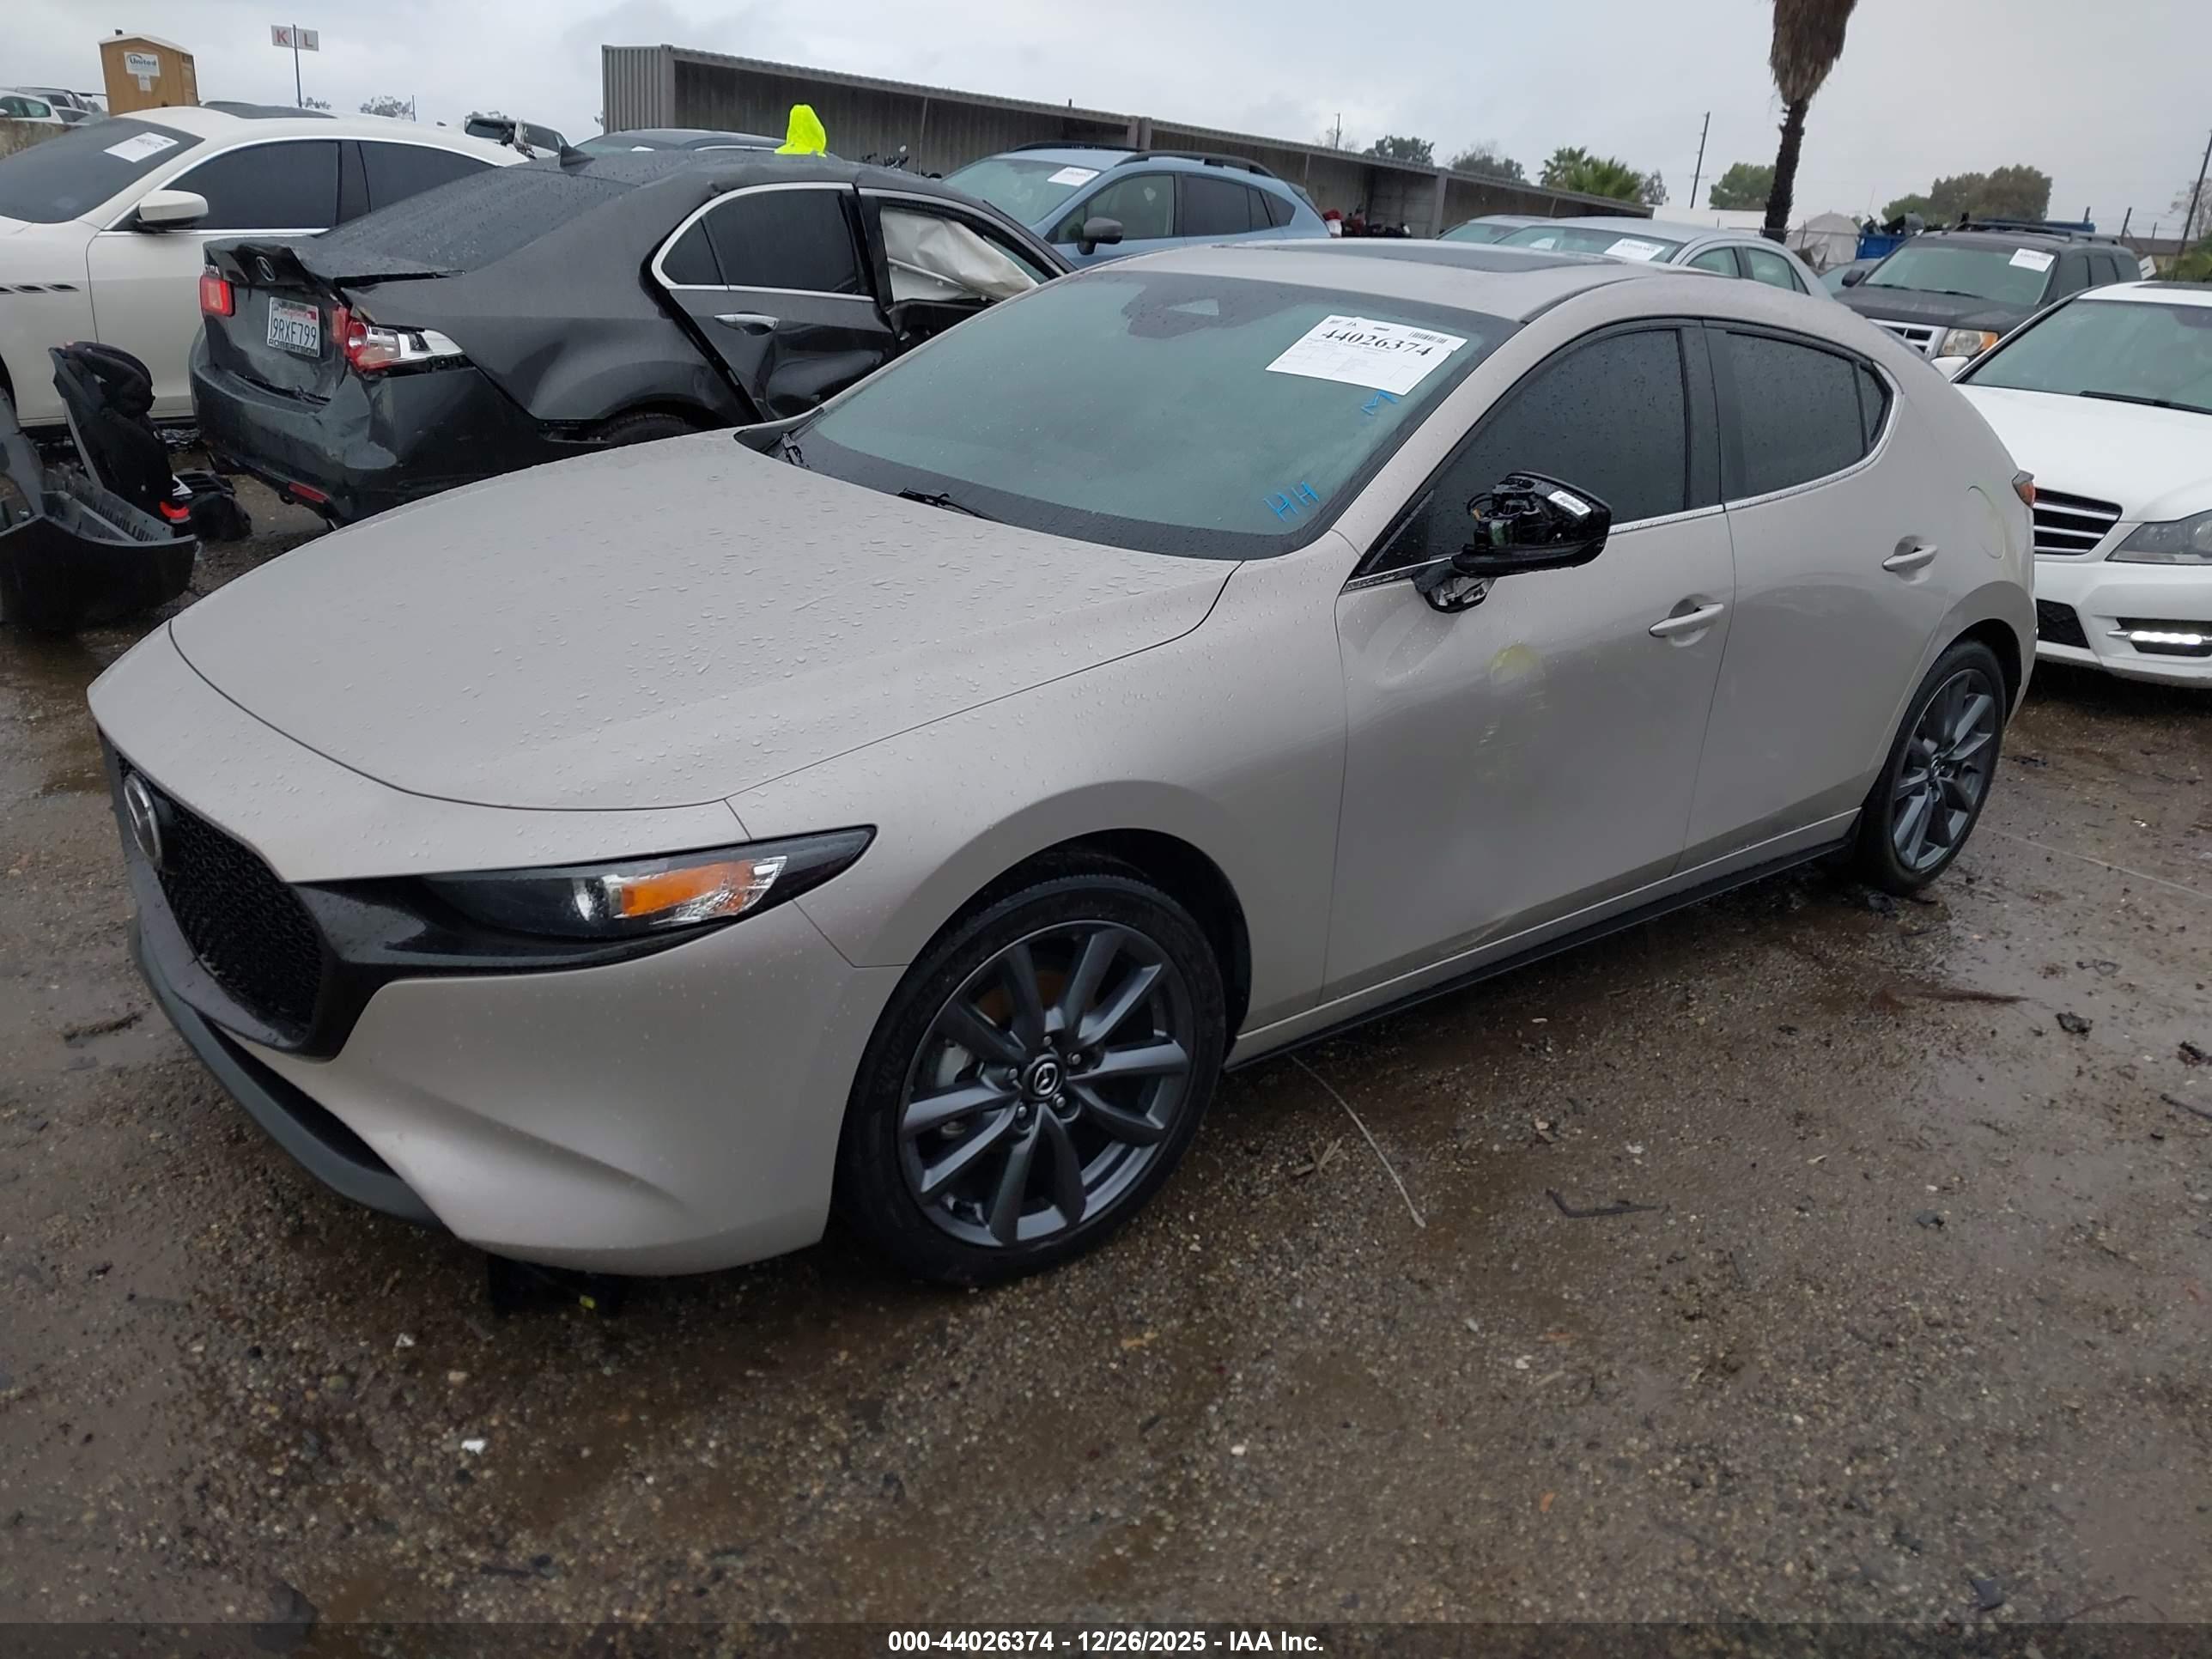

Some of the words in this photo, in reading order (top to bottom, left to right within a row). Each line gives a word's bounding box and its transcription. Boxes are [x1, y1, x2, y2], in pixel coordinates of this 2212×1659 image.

[276, 29, 289, 44] K
[303, 33, 313, 47] L
[272, 318, 317, 348] 9RXF799
[1322, 328, 1434, 356] 44026374
